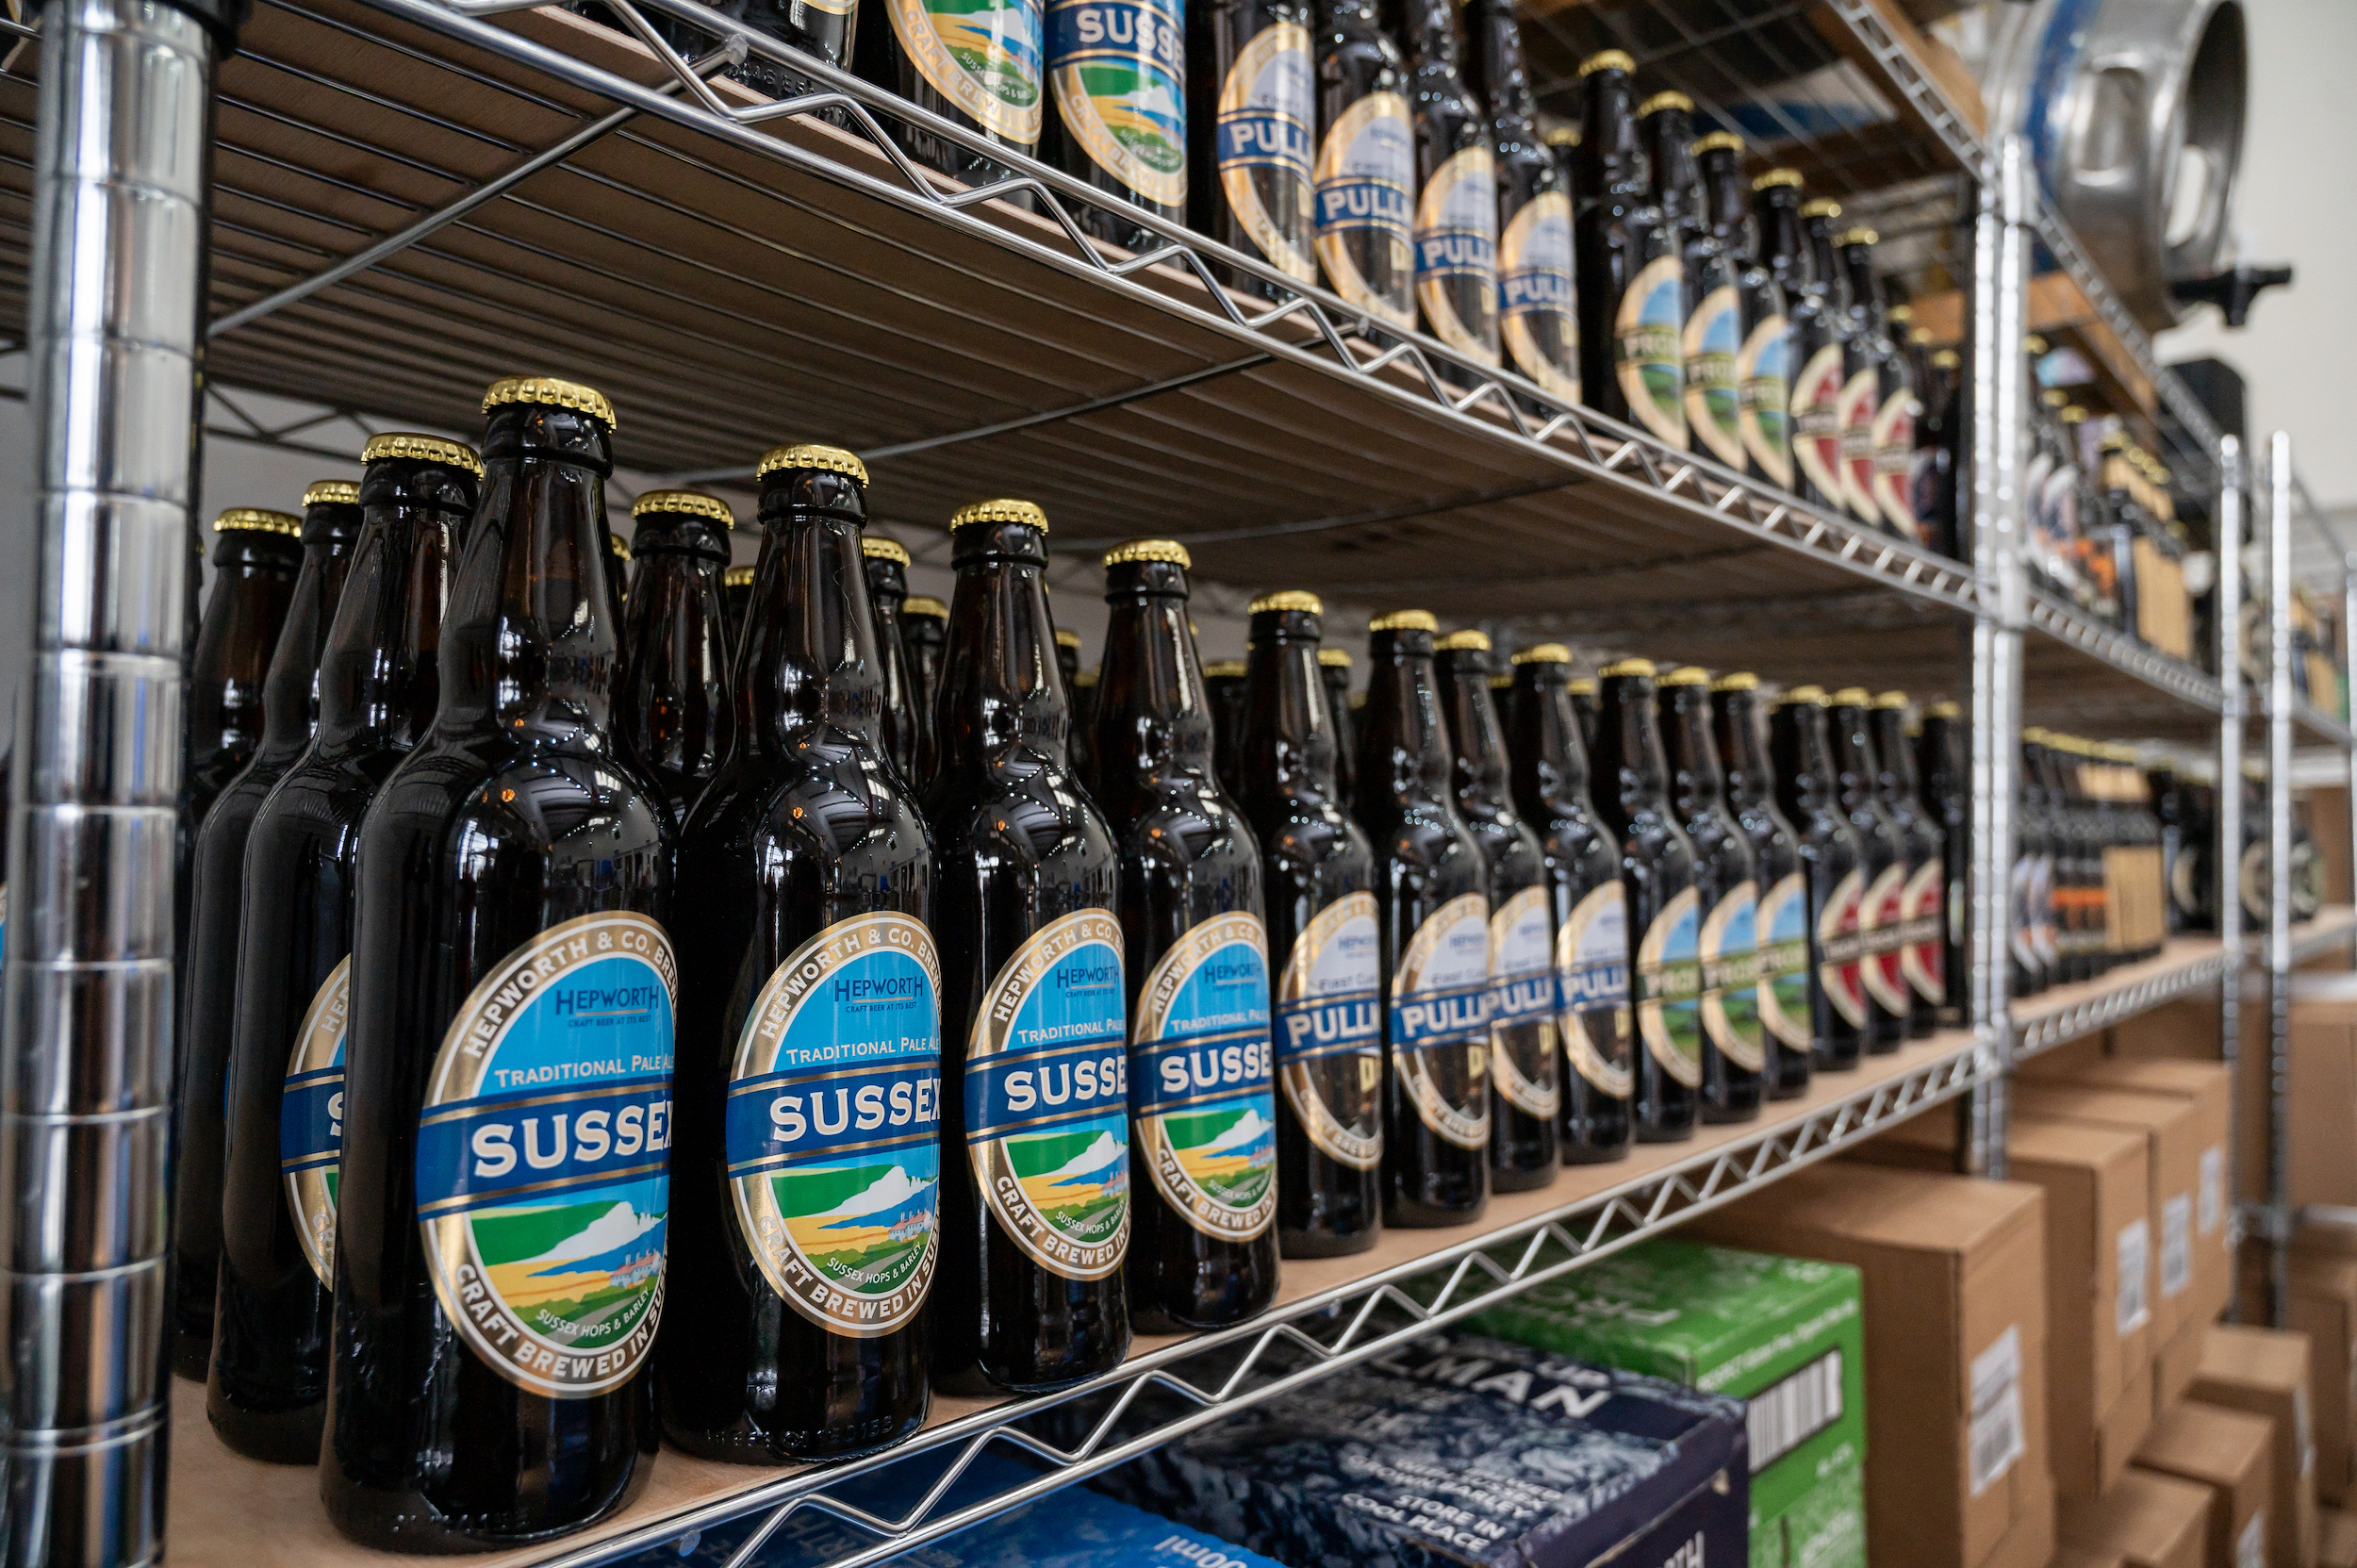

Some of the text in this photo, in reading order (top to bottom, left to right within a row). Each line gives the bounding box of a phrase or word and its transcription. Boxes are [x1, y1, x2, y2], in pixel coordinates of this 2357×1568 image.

[908, 10, 950, 68] CRAFT
[948, 70, 1020, 126] BREWED
[1229, 122, 1311, 164] PULL
[1422, 238, 1495, 269] PULL
[1504, 276, 1573, 305] PULL
[760, 933, 862, 1039] HEPWORTH
[868, 928, 882, 944] &
[888, 927, 914, 949] CO.
[834, 976, 923, 1002] HEPWORTH
[994, 923, 1113, 1023] HEPWORTH & CO.
[1057, 965, 1119, 989] HEPWORTH
[1151, 930, 1222, 1014] HEPWORTH
[1205, 963, 1261, 983] HEPWOR
[464, 937, 588, 1058] HEPWORTH
[597, 931, 613, 950] &
[621, 931, 651, 955] CO.
[556, 985, 659, 1015] HEPWORTH
[846, 1005, 866, 1014] CRAFT
[1066, 990, 1082, 999] CRAFT
[569, 1015, 651, 1028] CRAFT BEER AT ITS BEST
[1018, 1023, 1104, 1044] TRADITIONAL
[1171, 1012, 1246, 1033] TRADITIONAL
[494, 1058, 626, 1088] TRADITIONAL
[631, 1054, 661, 1072] PALE
[785, 1035, 940, 1065] TRADITIONAL PALE ALE
[1160, 1041, 1273, 1093] SUSSE
[1004, 1055, 1127, 1111] SUSSE
[769, 1077, 941, 1143] SUSSEX
[1157, 1148, 1198, 1203] CRAFT
[1197, 1199, 1261, 1228] BREWED
[997, 1176, 1046, 1238] CRAFT
[1043, 1234, 1114, 1264] BREWED
[1055, 1211, 1085, 1232] SUSSEX
[1086, 1223, 1105, 1234] HOPS
[1105, 1220, 1111, 1230] &
[760, 1215, 814, 1287] CRAFT
[809, 1283, 903, 1319] BREWED
[902, 1277, 922, 1302] IN
[827, 1241, 922, 1284] SUSSEX HOPS & BARLEY
[455, 1263, 519, 1346] CRAFT
[514, 1338, 626, 1378] BREWED
[630, 1324, 650, 1355] IN
[536, 1286, 650, 1337] SUSSEX HOPS & BARLEY
[1393, 1494, 1508, 1540] STORE IN
[1438, 1481, 1535, 1519] BARLEY
[1342, 1493, 1491, 1554] COOL PLACE
